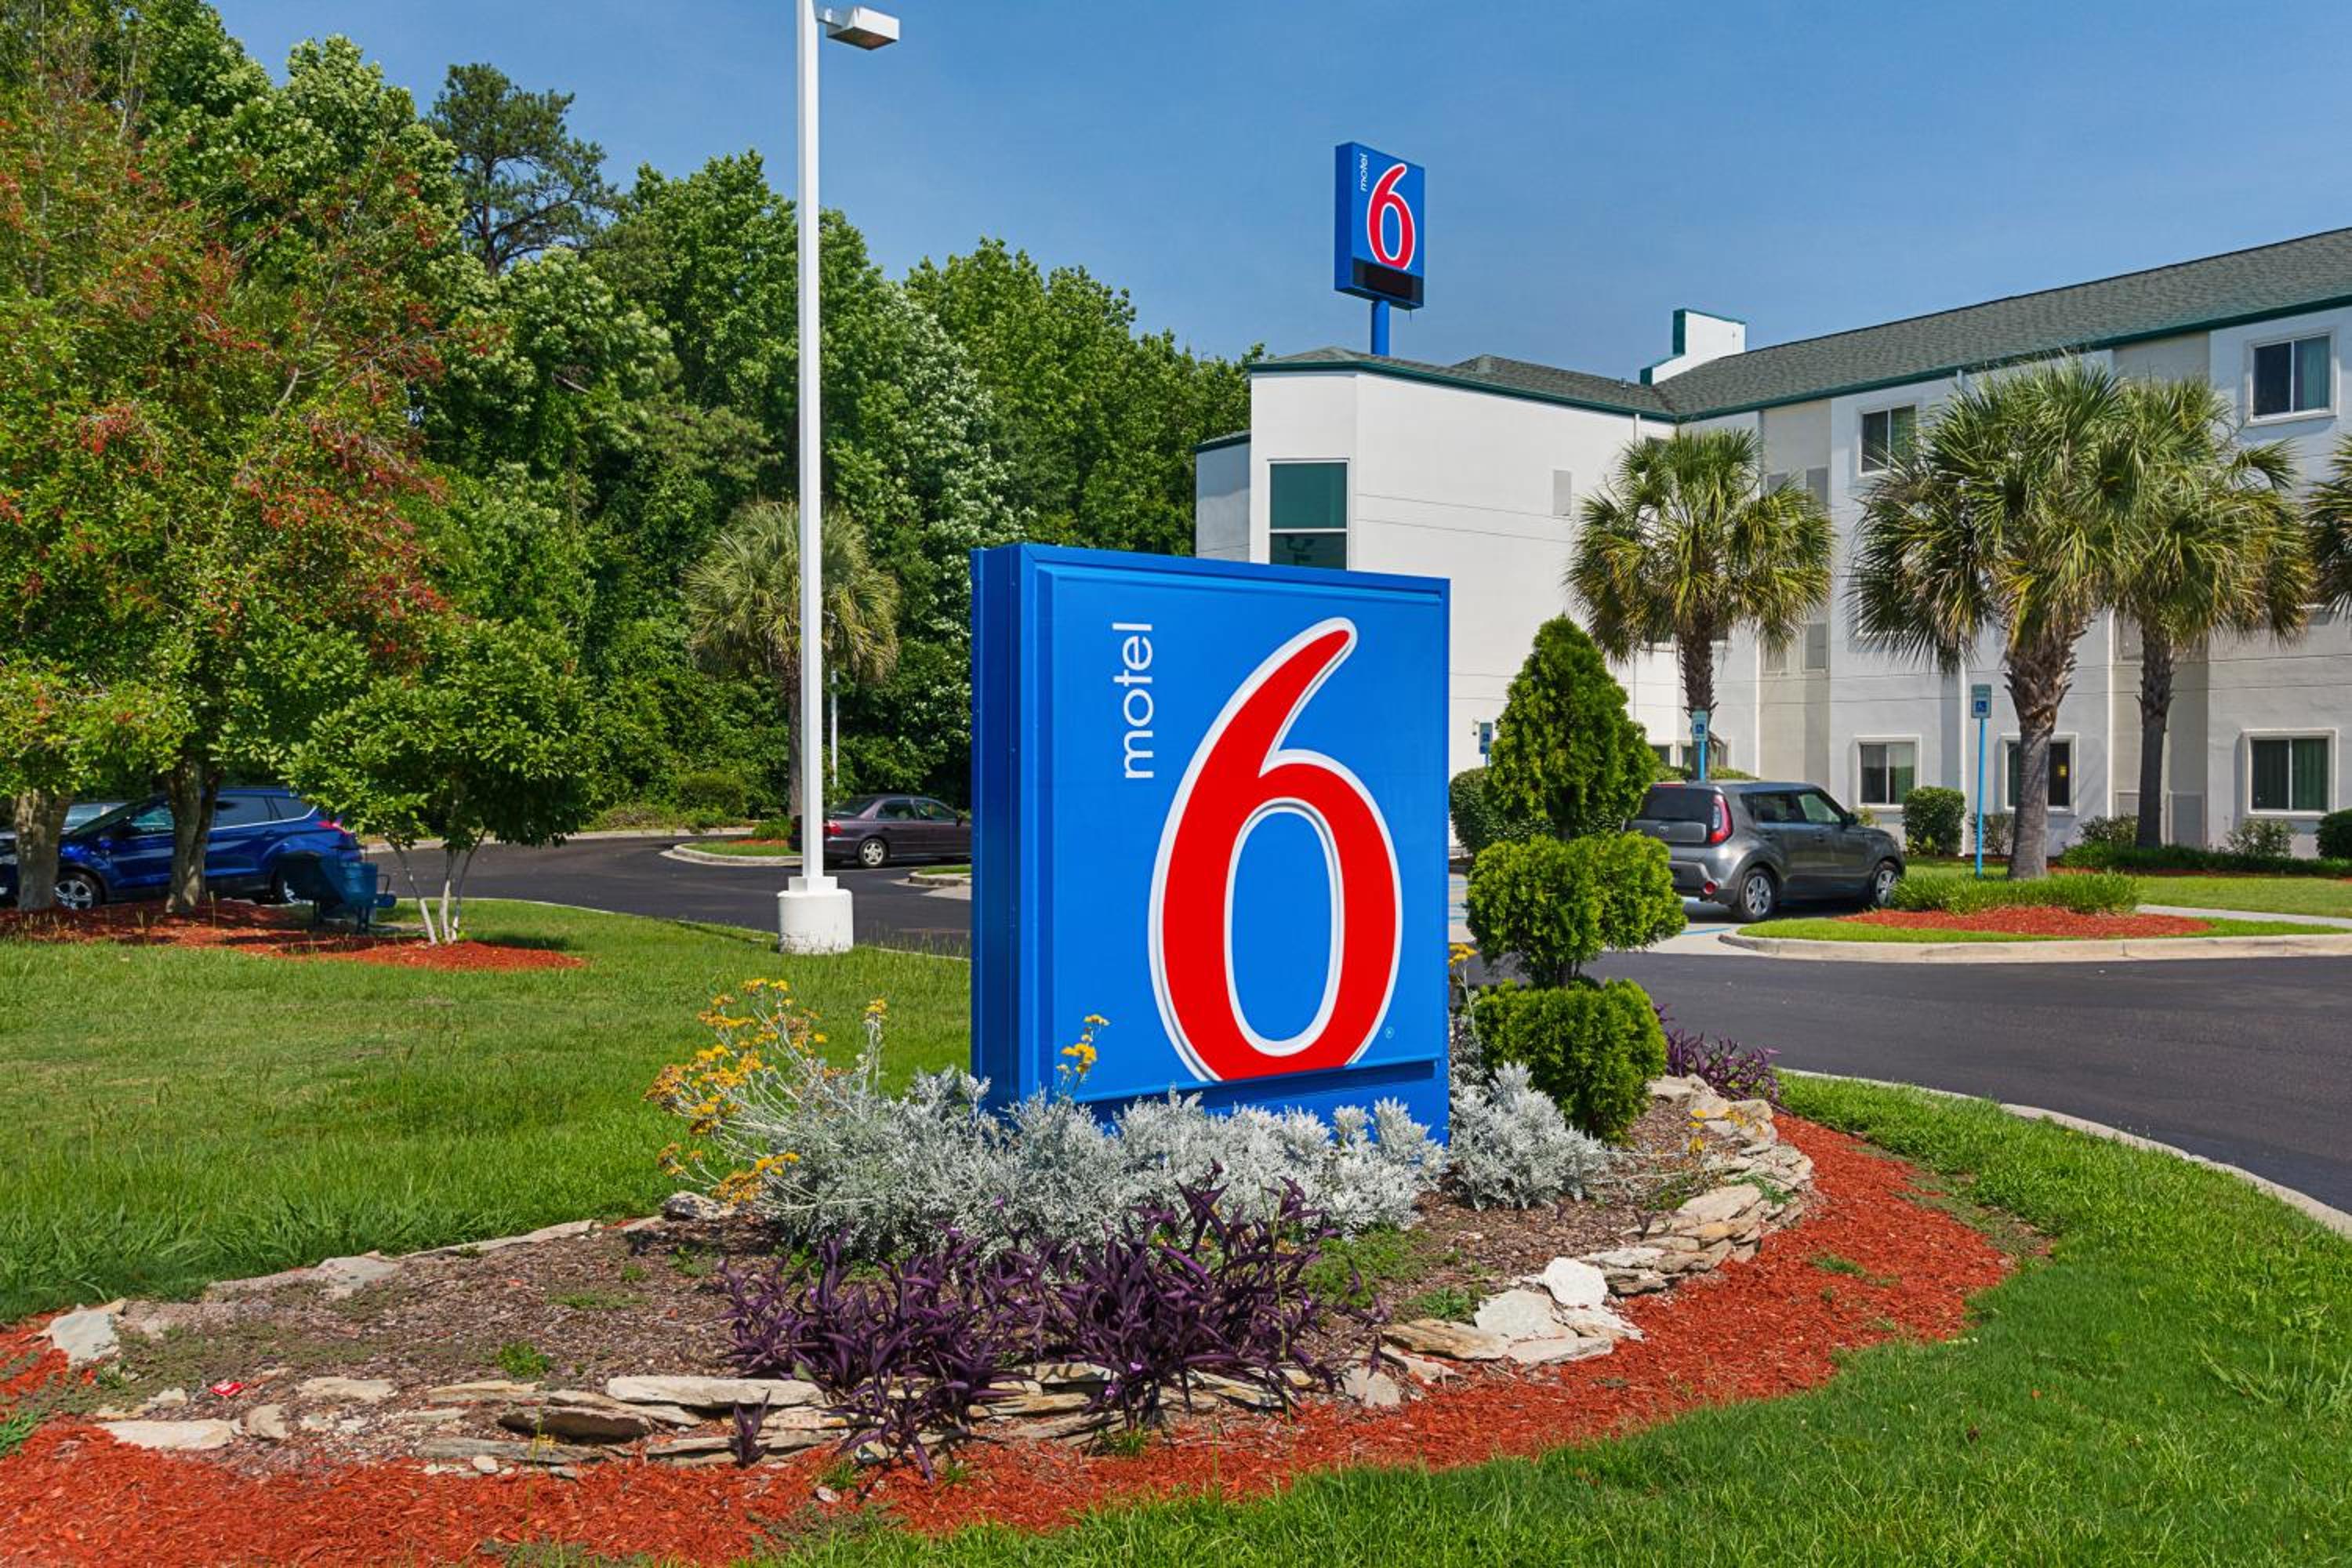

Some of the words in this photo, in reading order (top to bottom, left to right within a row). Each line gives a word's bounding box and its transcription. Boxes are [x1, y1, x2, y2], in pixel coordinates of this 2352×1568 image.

[1359, 153, 1368, 192] motel
[1367, 163, 1416, 270] 6
[1112, 622, 1154, 779] motel
[1148, 617, 1403, 1081] 6
